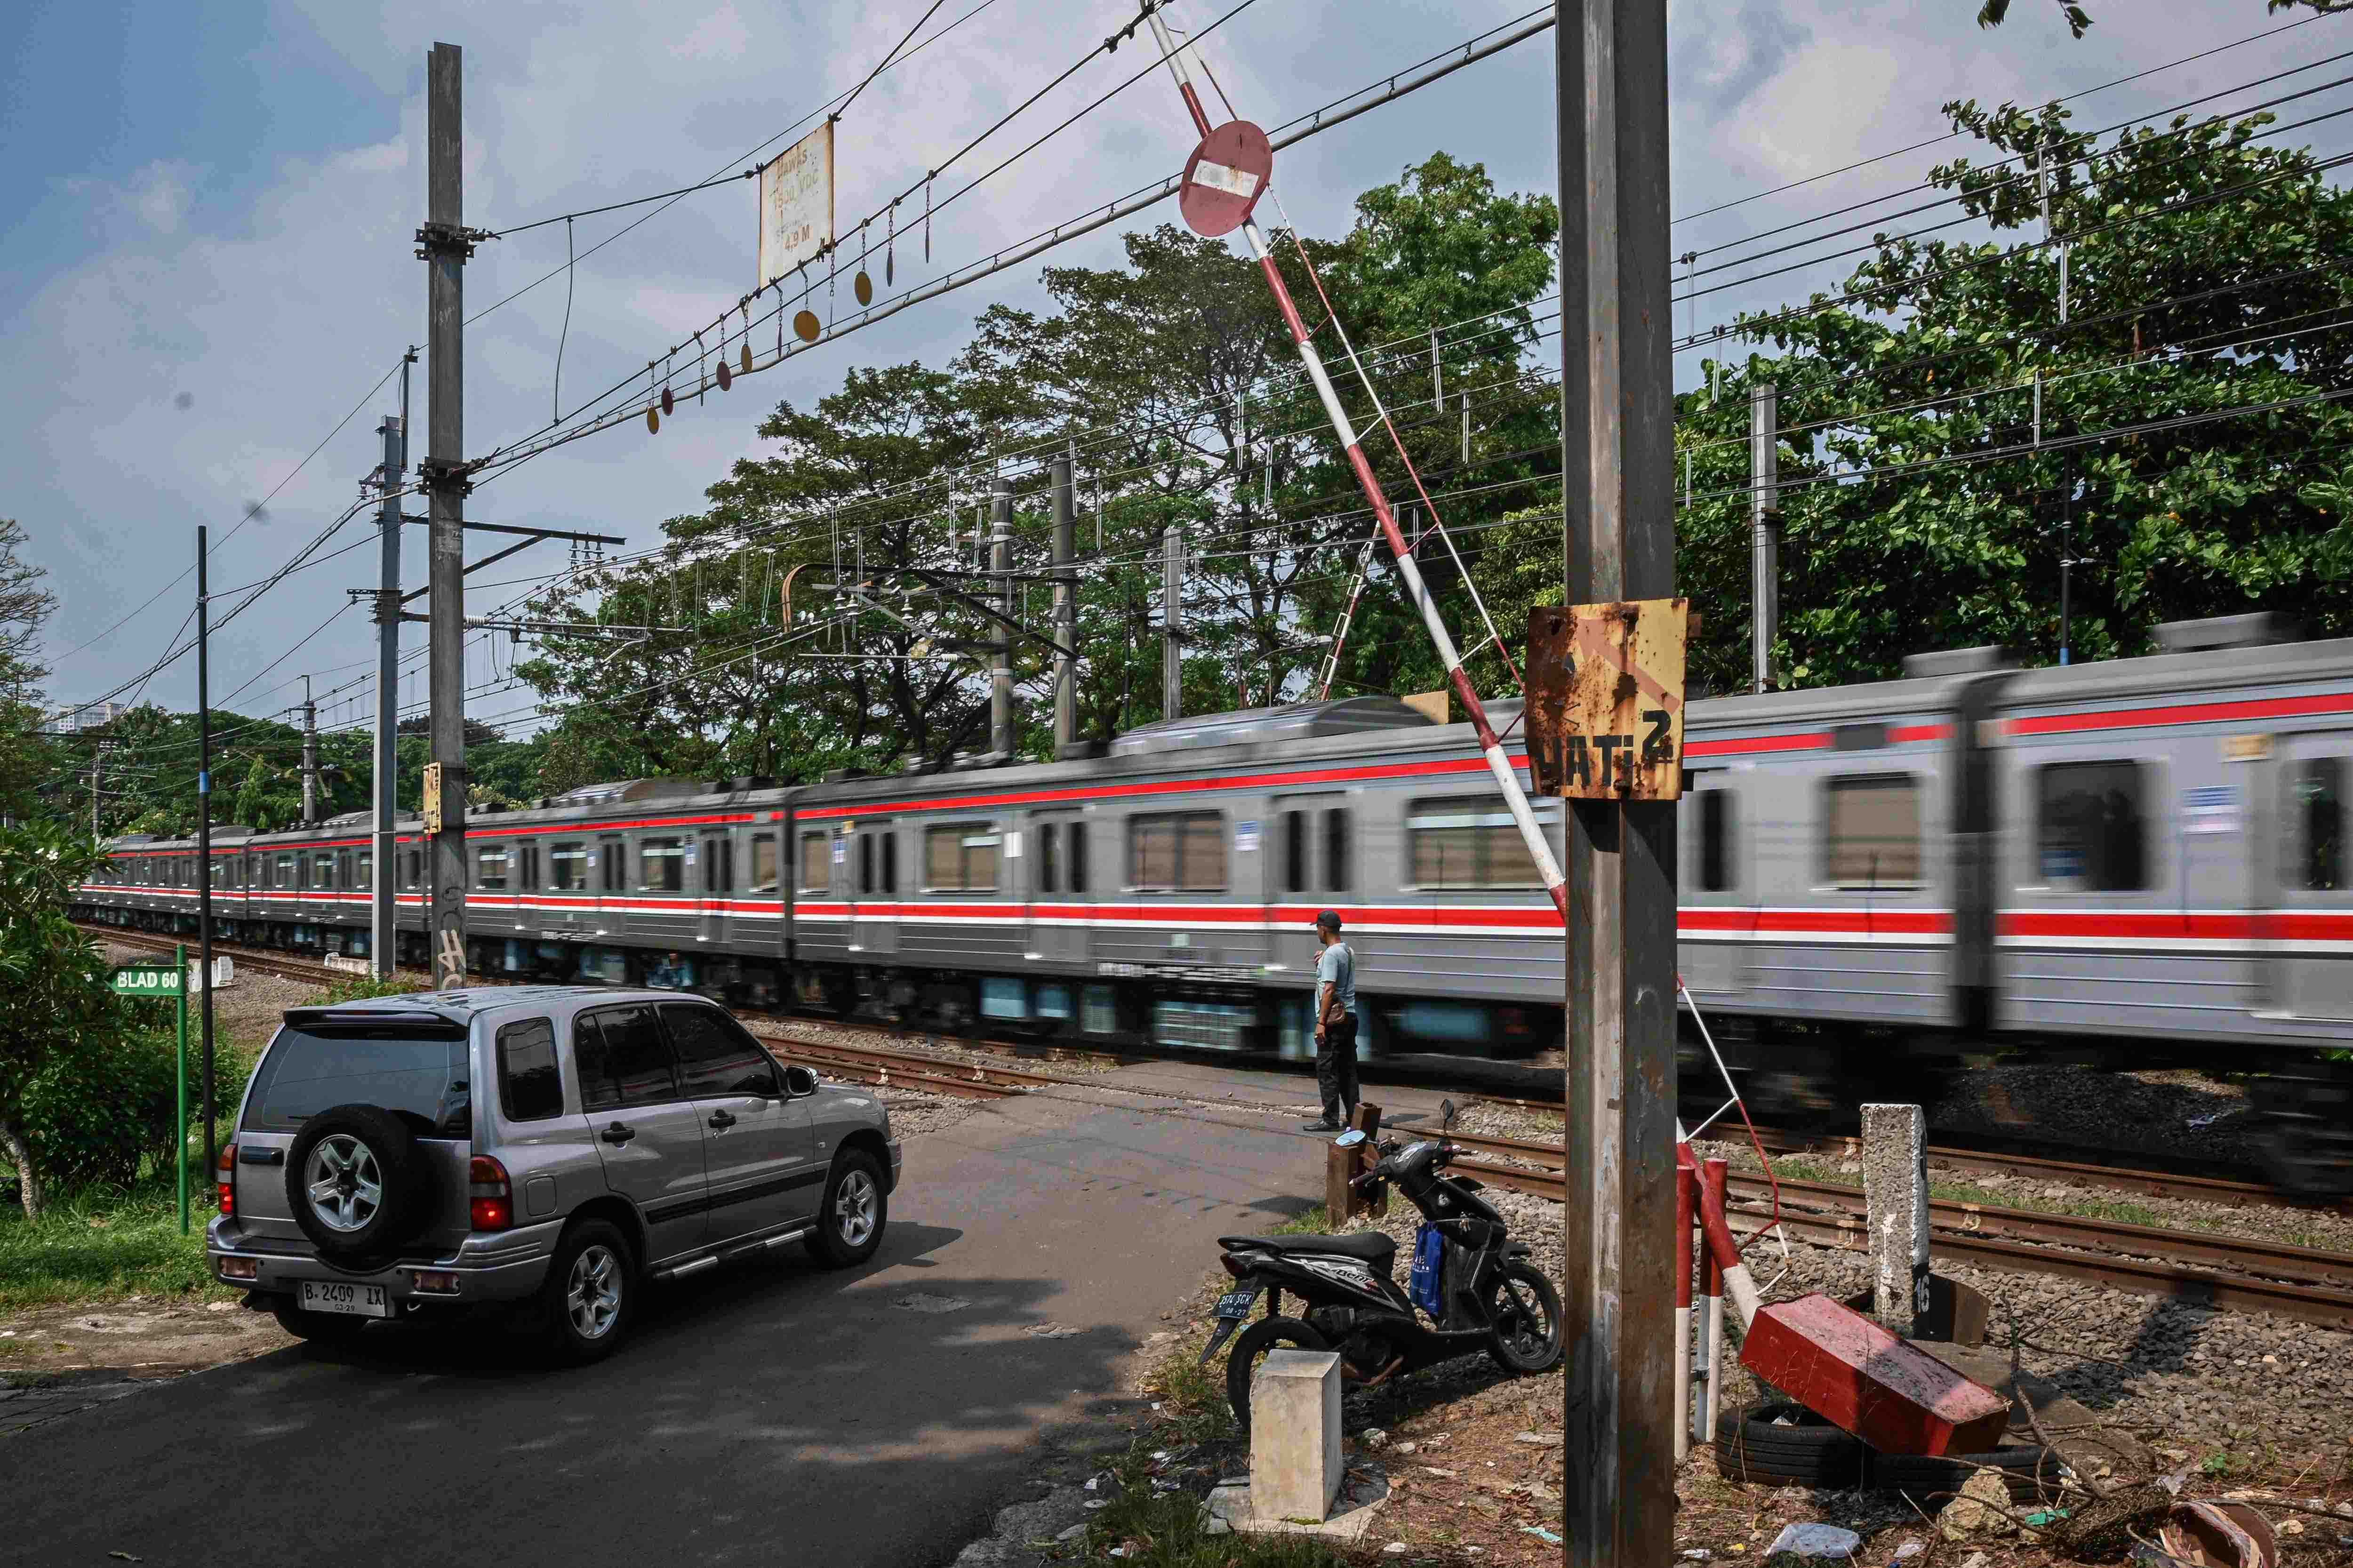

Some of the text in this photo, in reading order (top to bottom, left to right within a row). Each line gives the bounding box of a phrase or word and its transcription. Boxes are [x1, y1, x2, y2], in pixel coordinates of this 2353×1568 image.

[801, 224, 810, 242] M
[117, 972, 178, 988] BLAD 60
